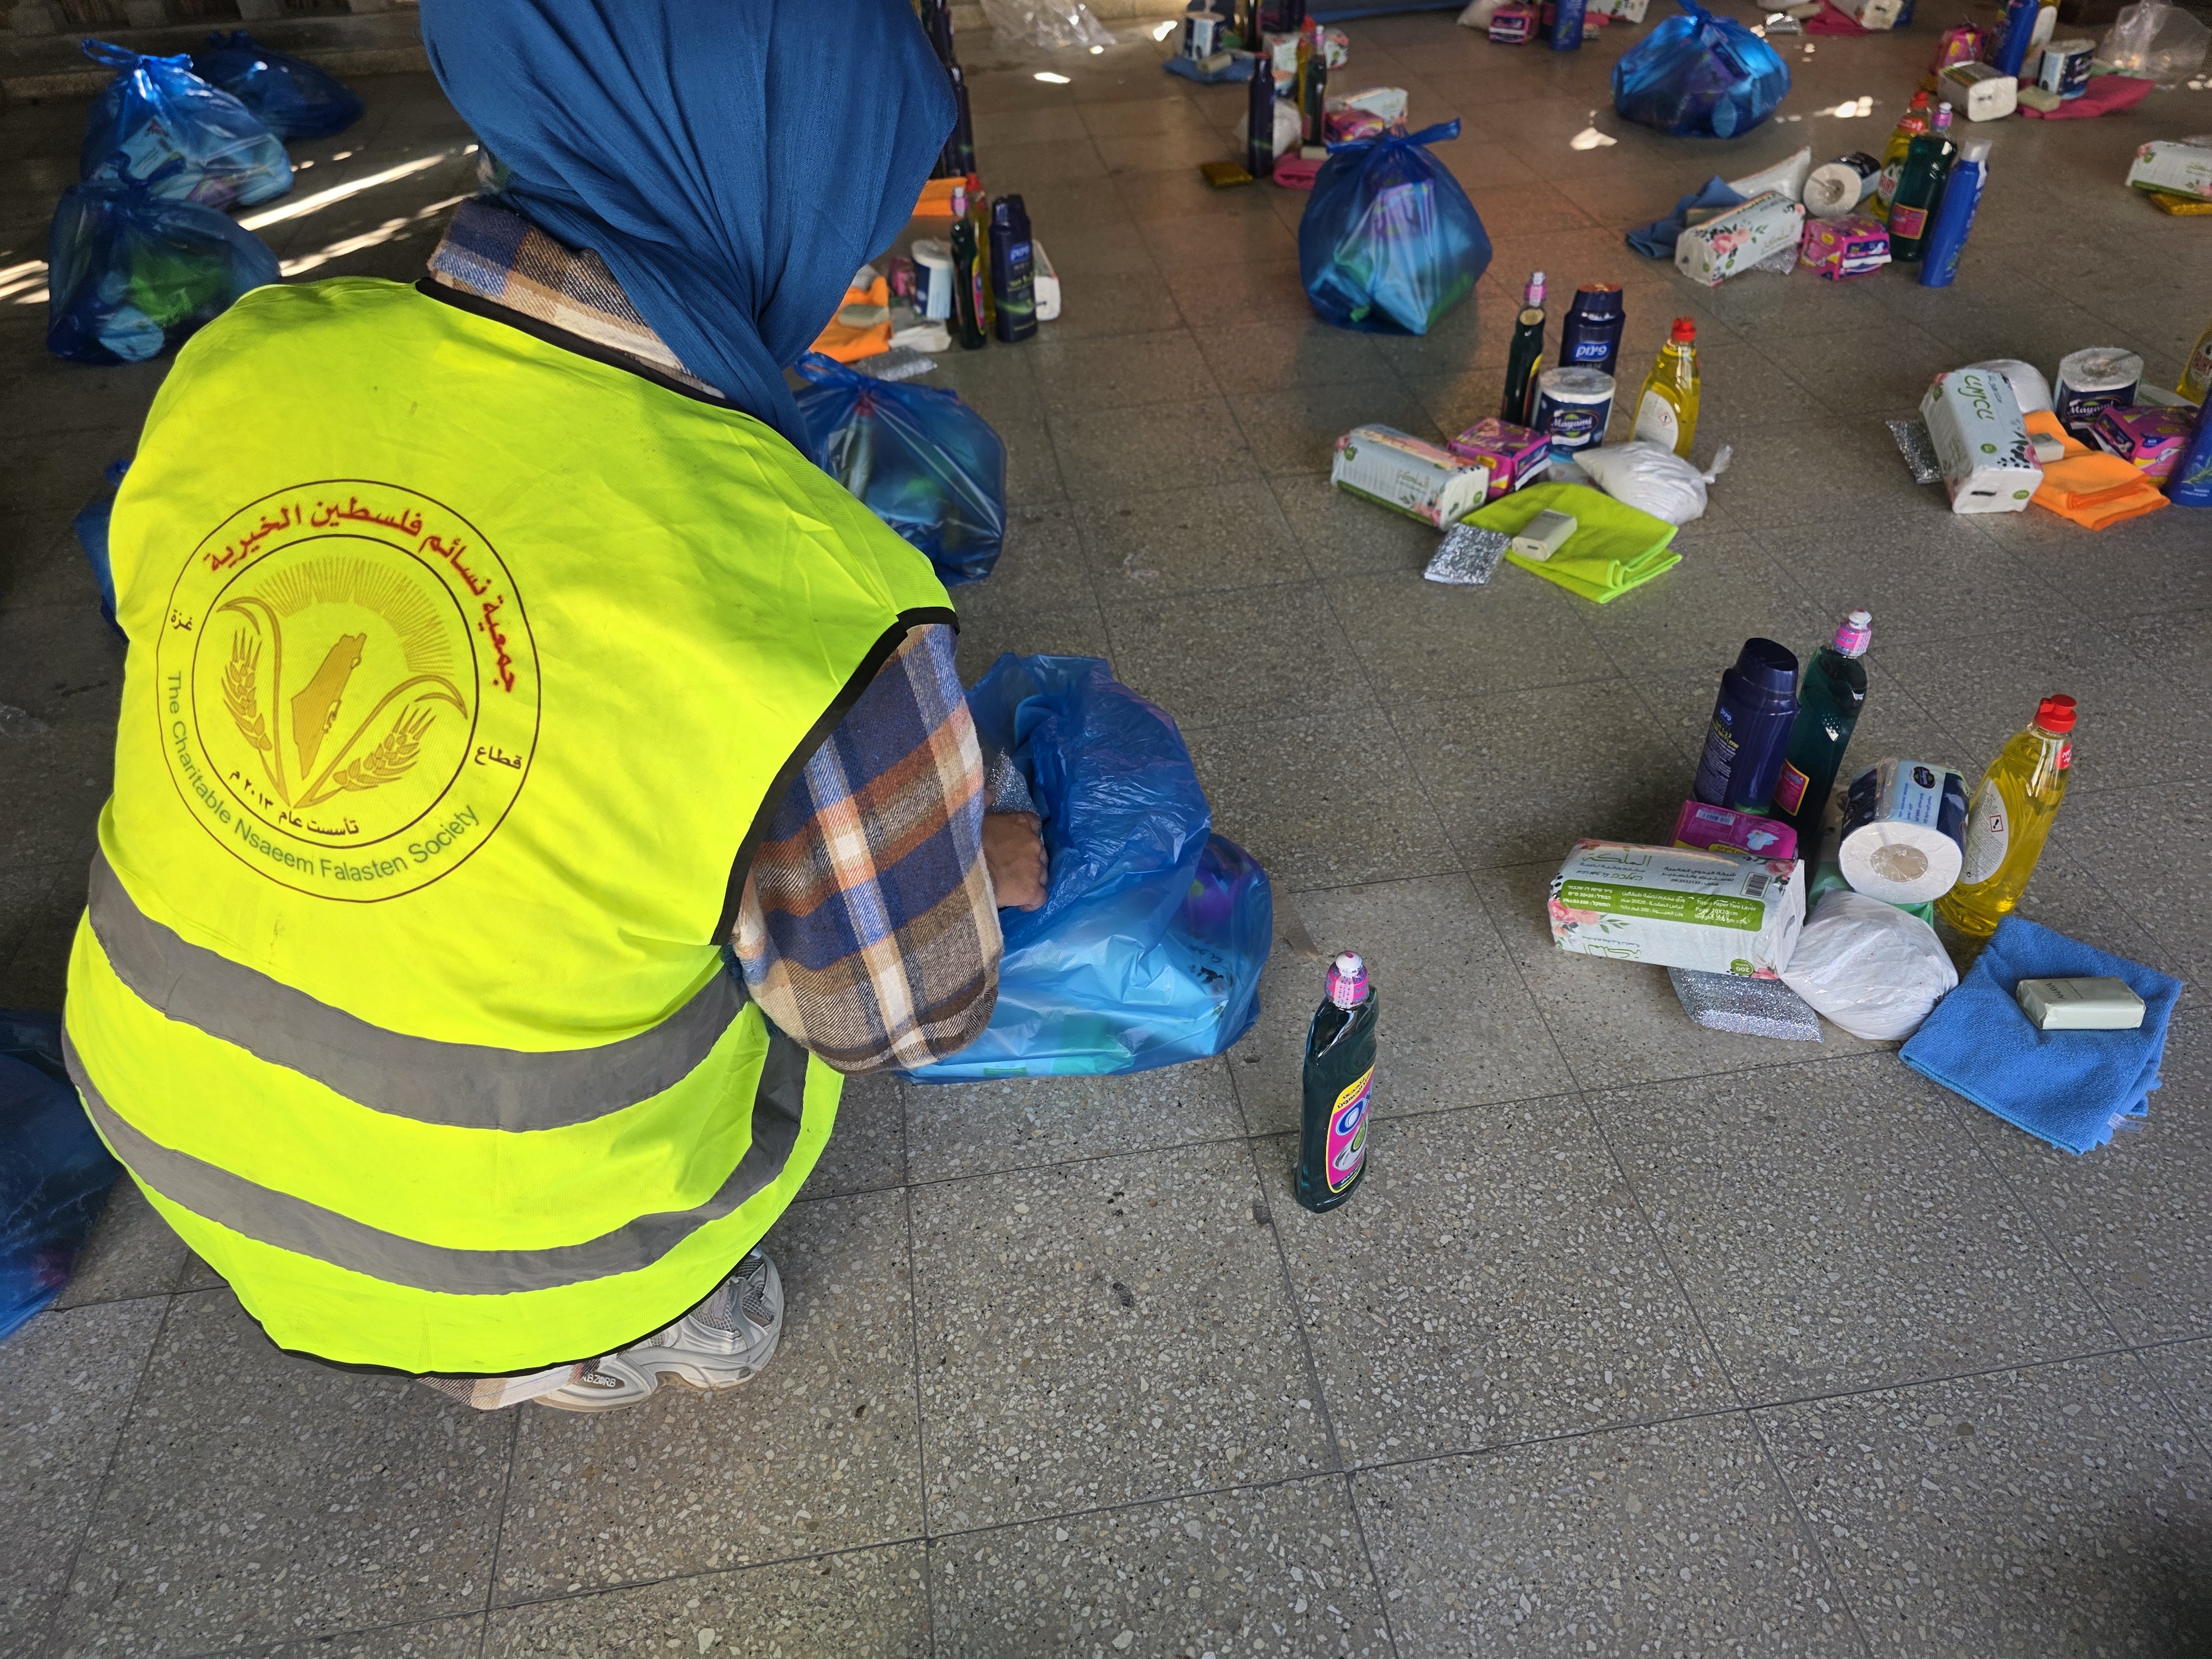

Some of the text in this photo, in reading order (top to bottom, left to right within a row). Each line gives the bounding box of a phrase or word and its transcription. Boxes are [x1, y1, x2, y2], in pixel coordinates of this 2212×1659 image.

[204, 496, 515, 693] جمعية نسائم فلسطين الخيرية
[170, 609, 522, 769] قطاع غزة
[168, 671, 479, 881] The Charitable Nsaeem Falasten Society
[279, 810, 303, 828] عام
[307, 818, 359, 835] تأسست
[1582, 853, 1652, 867] الملكة
[1610, 872, 1643, 881] המלכה
